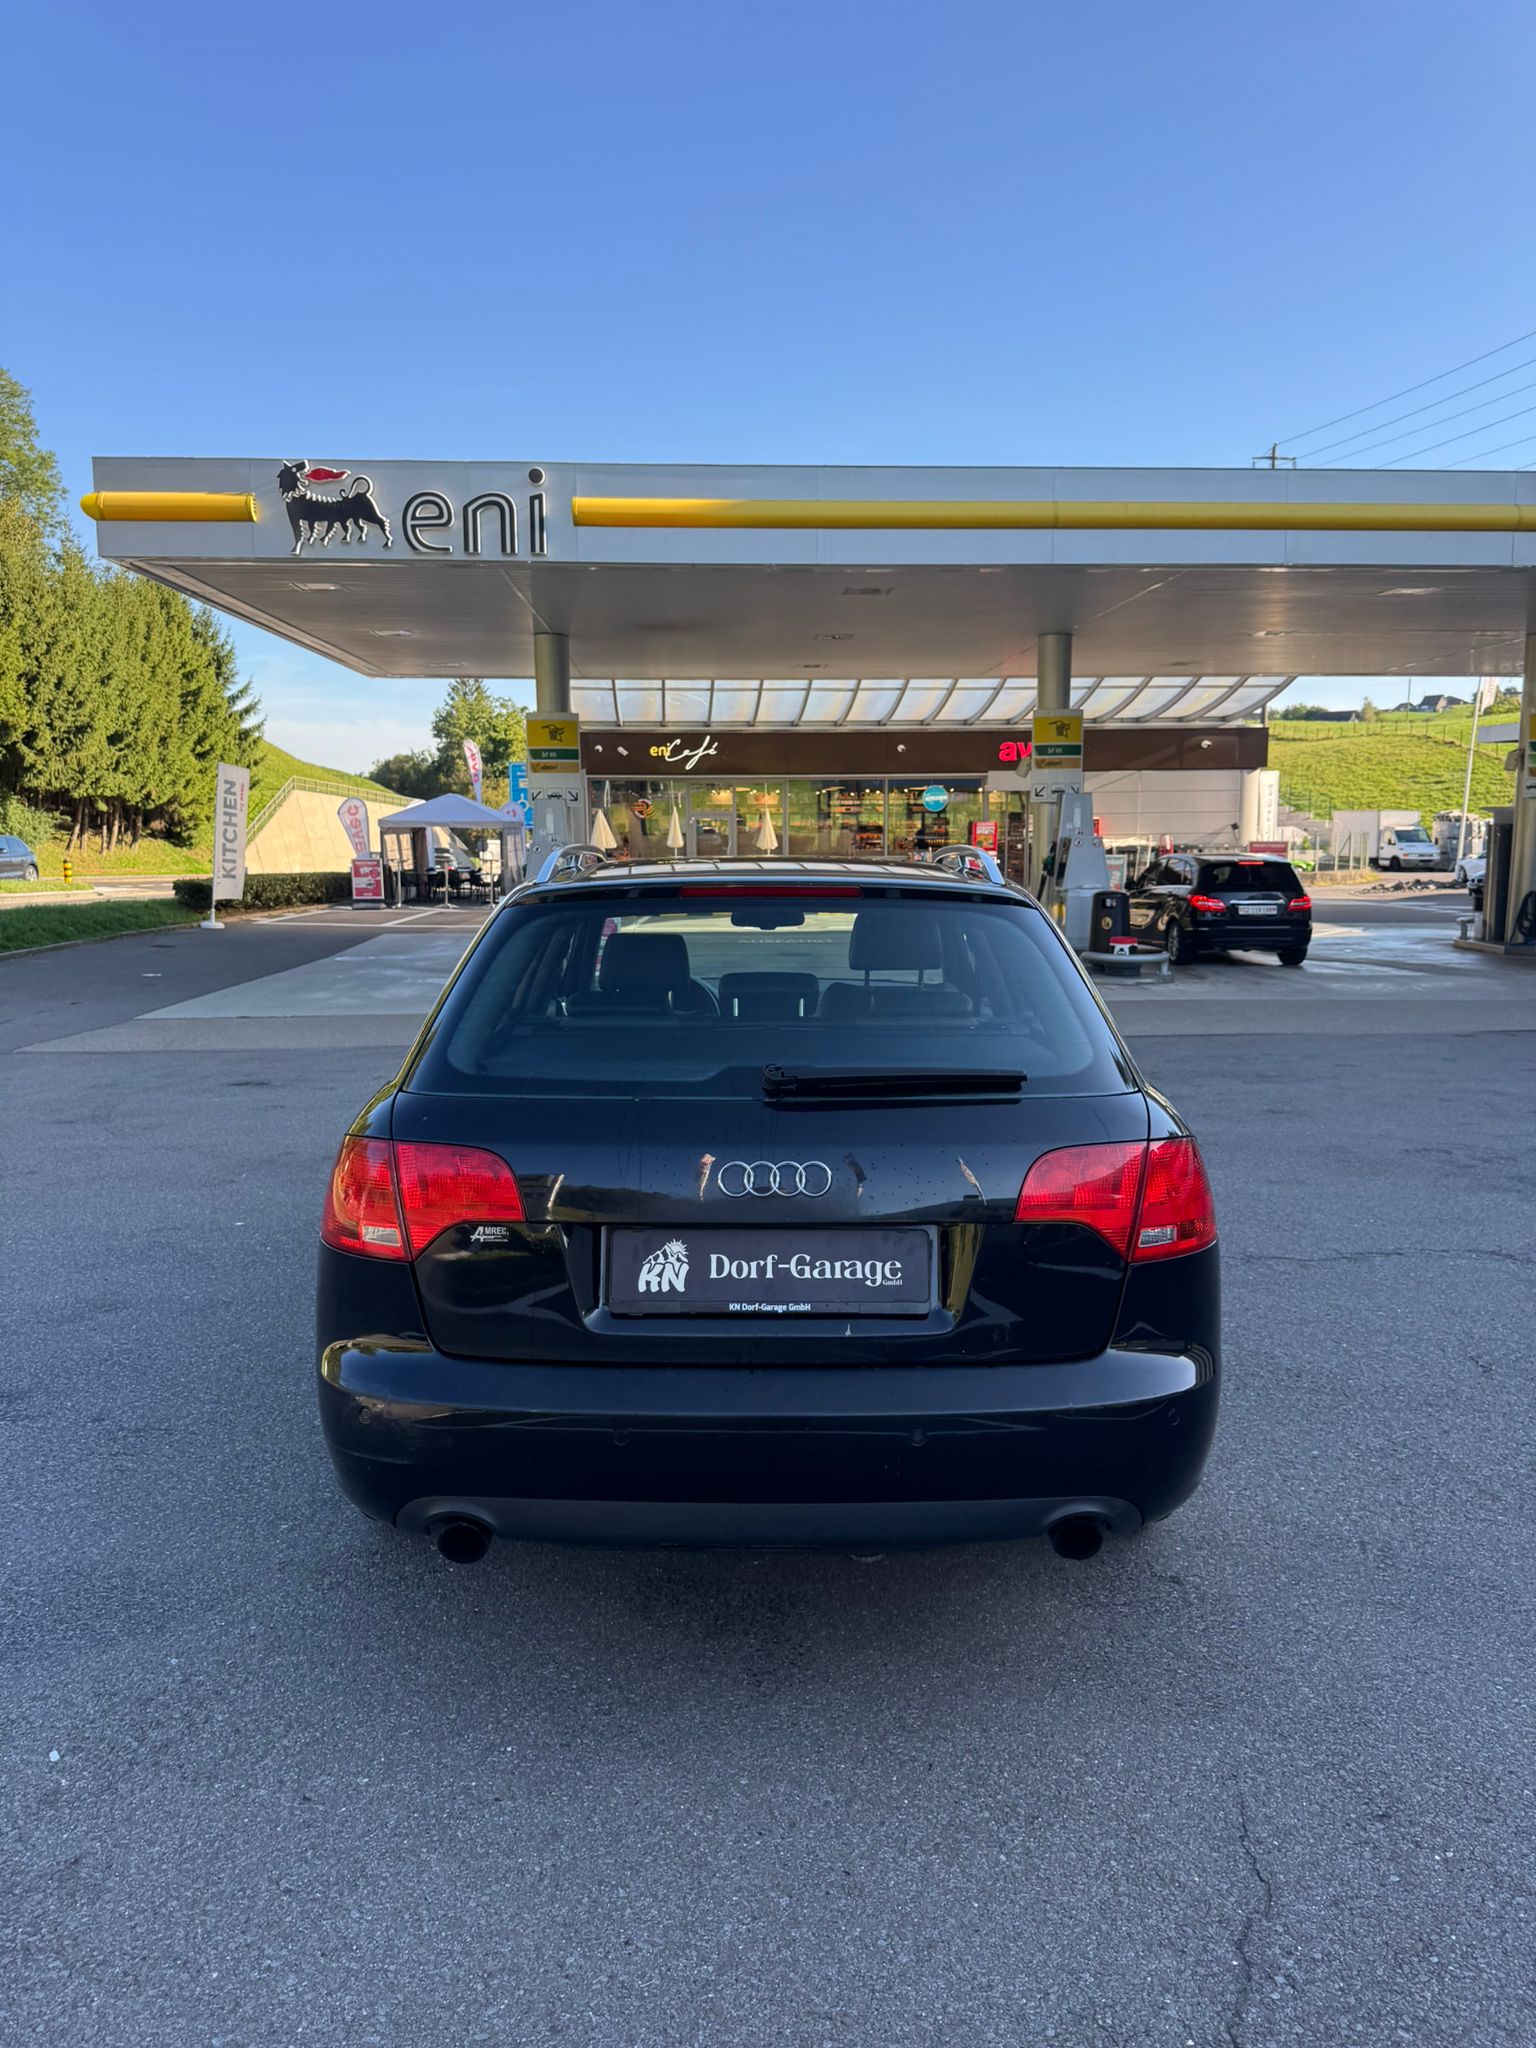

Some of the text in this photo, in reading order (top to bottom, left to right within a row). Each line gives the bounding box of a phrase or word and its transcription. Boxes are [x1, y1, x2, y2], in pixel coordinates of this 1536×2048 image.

[402, 466, 547, 555] eni
[649, 735, 719, 770] eni Café
[998, 741, 1032, 761] av
[221, 779, 238, 880] KITCHEN
[638, 1262, 690, 1293] KN
[709, 1254, 902, 1287] Dorf-Garage
[729, 1302, 811, 1313] KN Dorf-Garage GmbH
